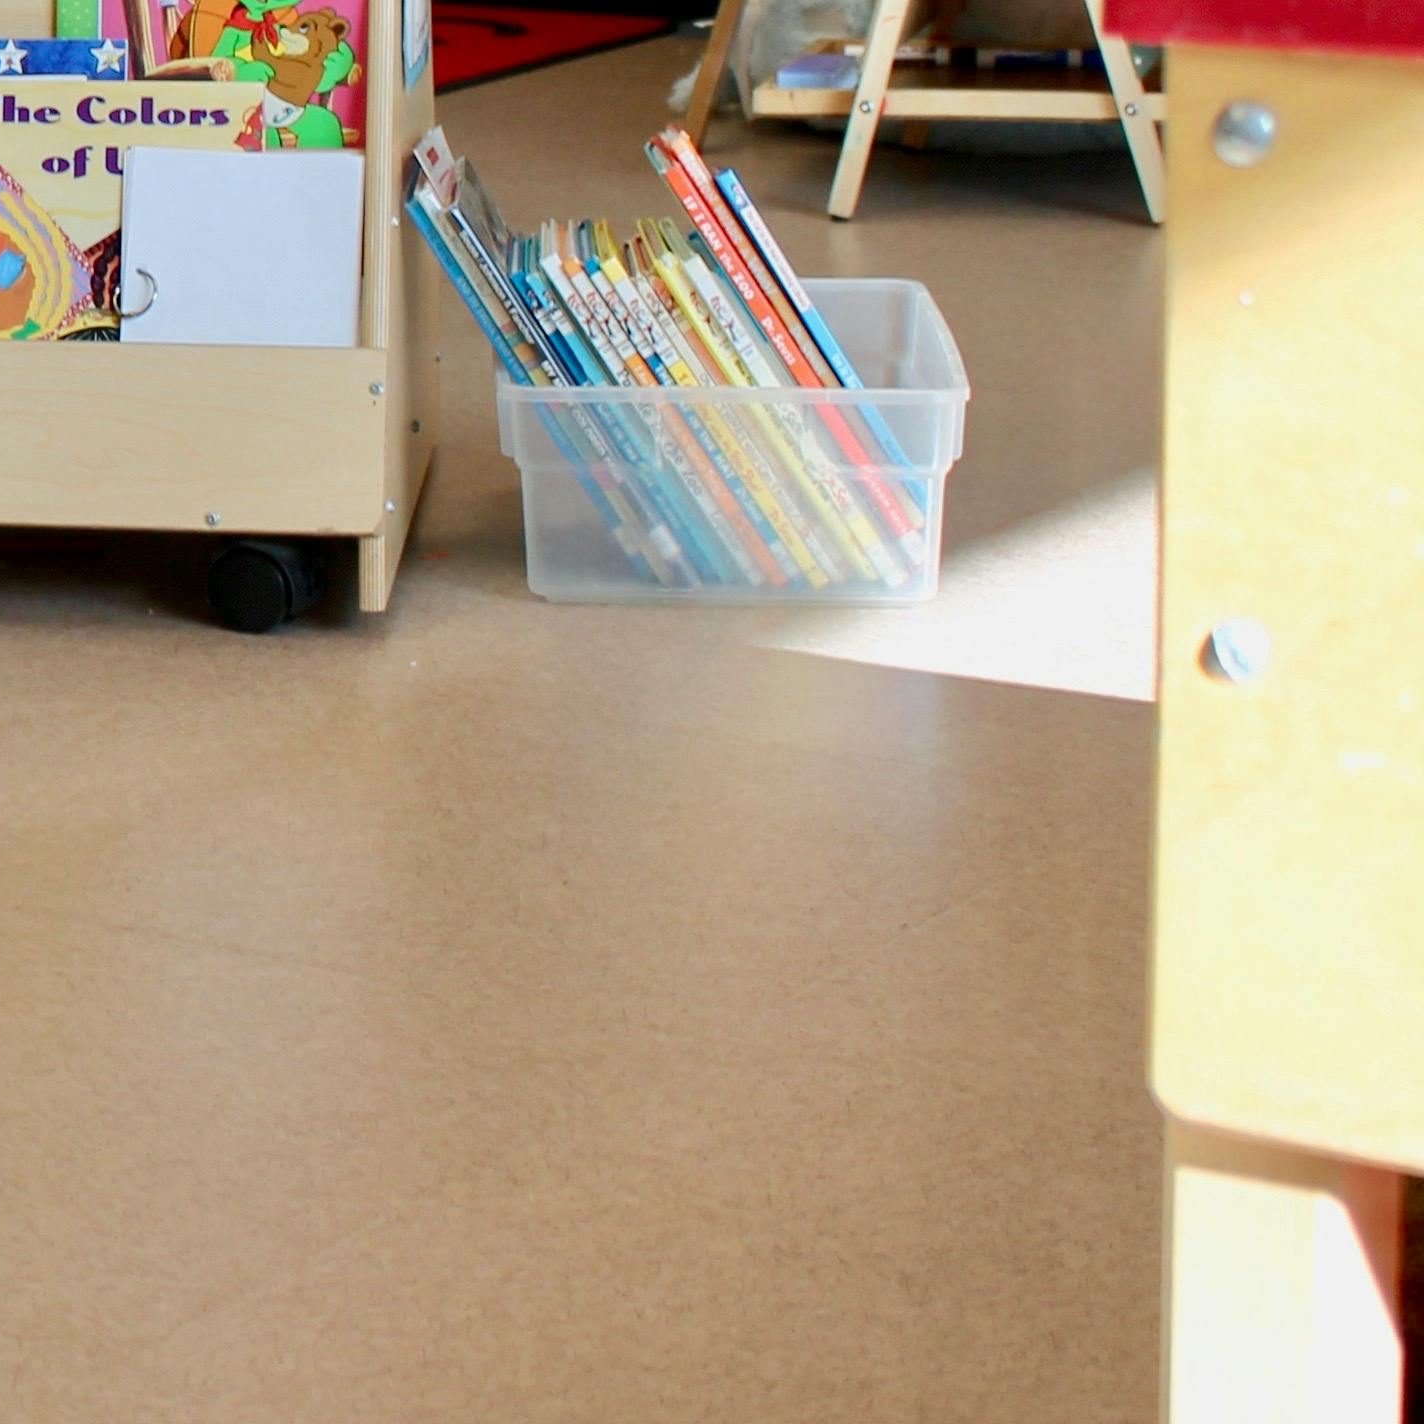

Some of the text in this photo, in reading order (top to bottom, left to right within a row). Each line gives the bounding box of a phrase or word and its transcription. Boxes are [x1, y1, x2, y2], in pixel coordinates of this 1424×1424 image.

[74, 95, 232, 127] Colors
[41, 147, 90, 178] of
[681, 194, 799, 367] IF I RAN the ZOO Dr. Seuss
[712, 452, 736, 480] HAT
